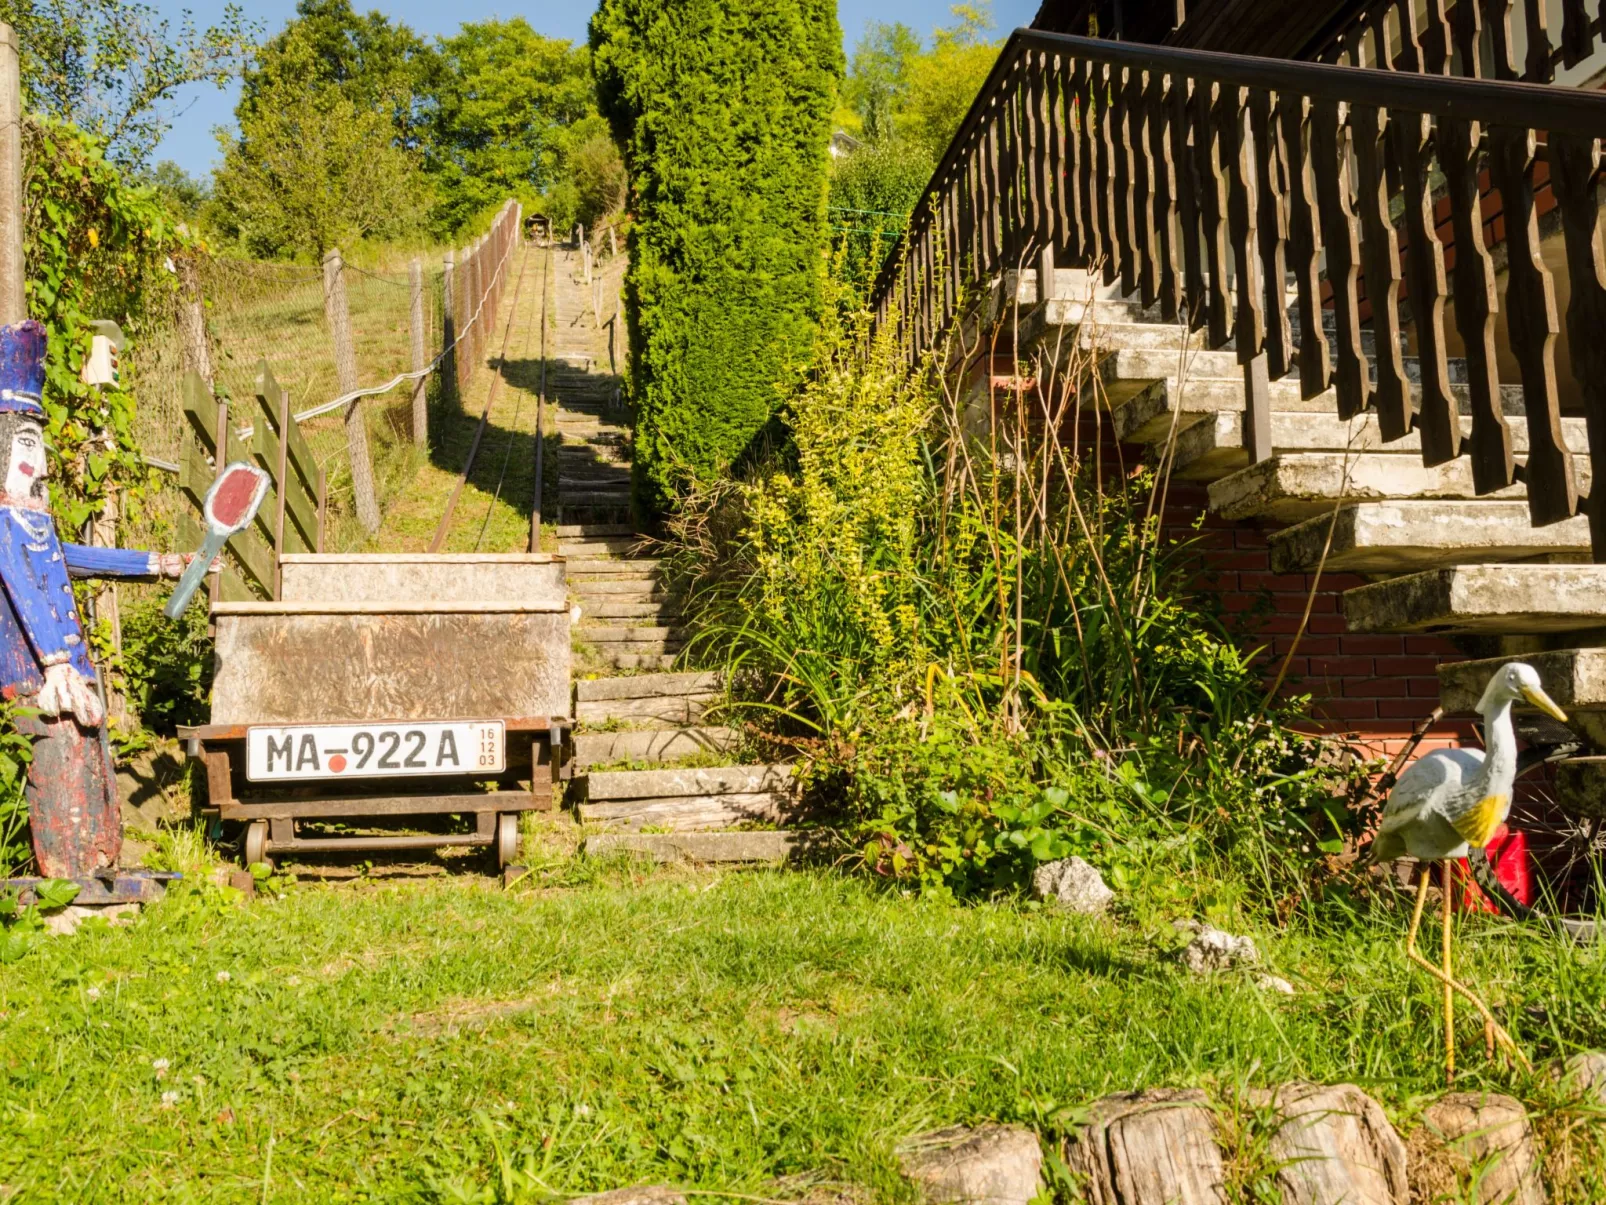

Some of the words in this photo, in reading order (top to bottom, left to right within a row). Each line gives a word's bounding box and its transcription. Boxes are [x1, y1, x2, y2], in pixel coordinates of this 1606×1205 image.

[480, 728, 495, 740] 16
[480, 741, 495, 753] 12
[479, 754, 496, 766] 03
